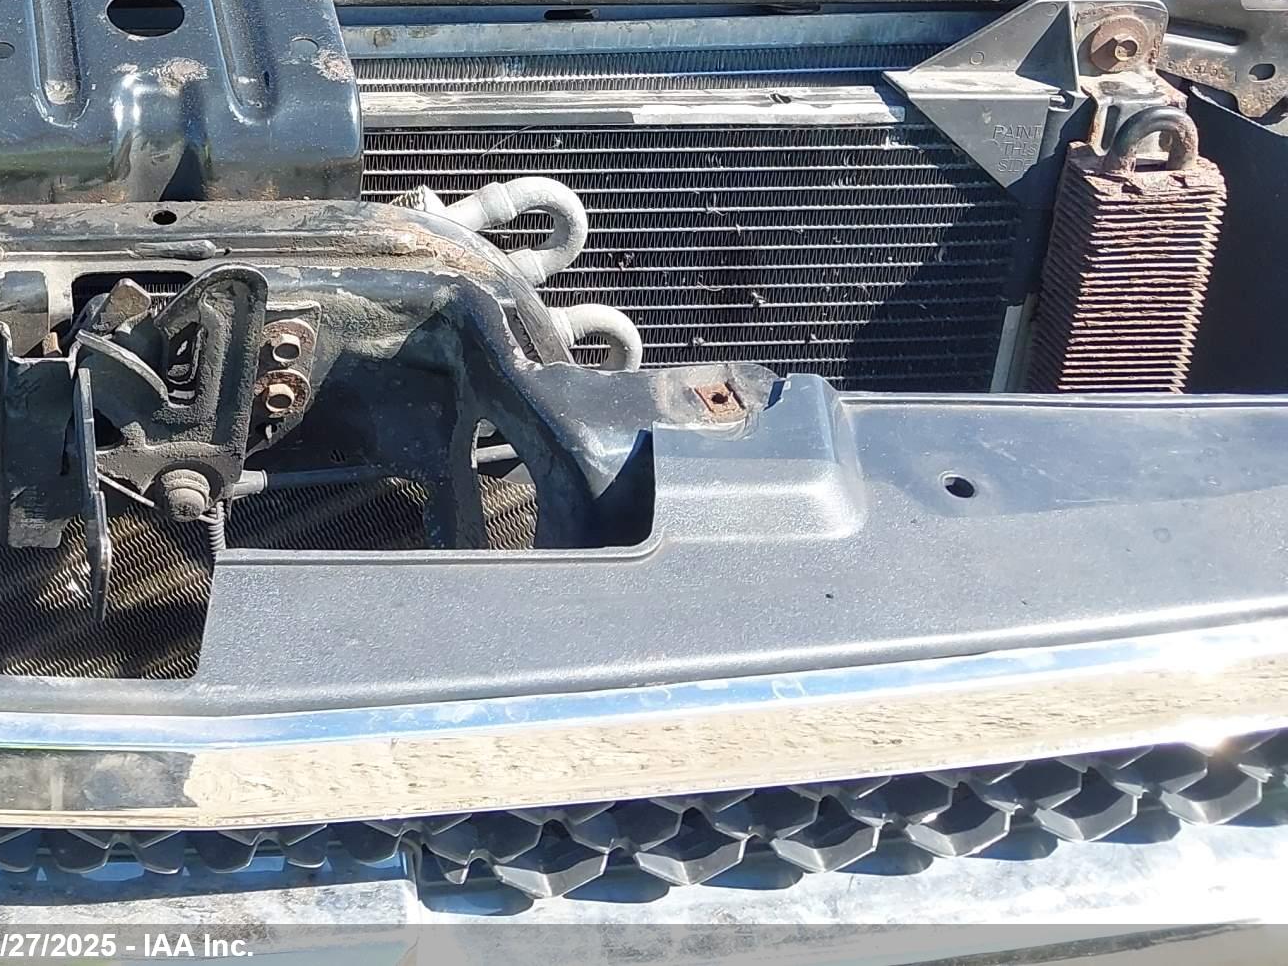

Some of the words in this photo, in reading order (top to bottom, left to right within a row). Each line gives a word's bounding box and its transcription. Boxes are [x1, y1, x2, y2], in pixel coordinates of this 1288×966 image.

[993, 124, 1042, 139] PAINT
[1001, 141, 1037, 156] THIS
[998, 158, 1034, 172] SIDE
